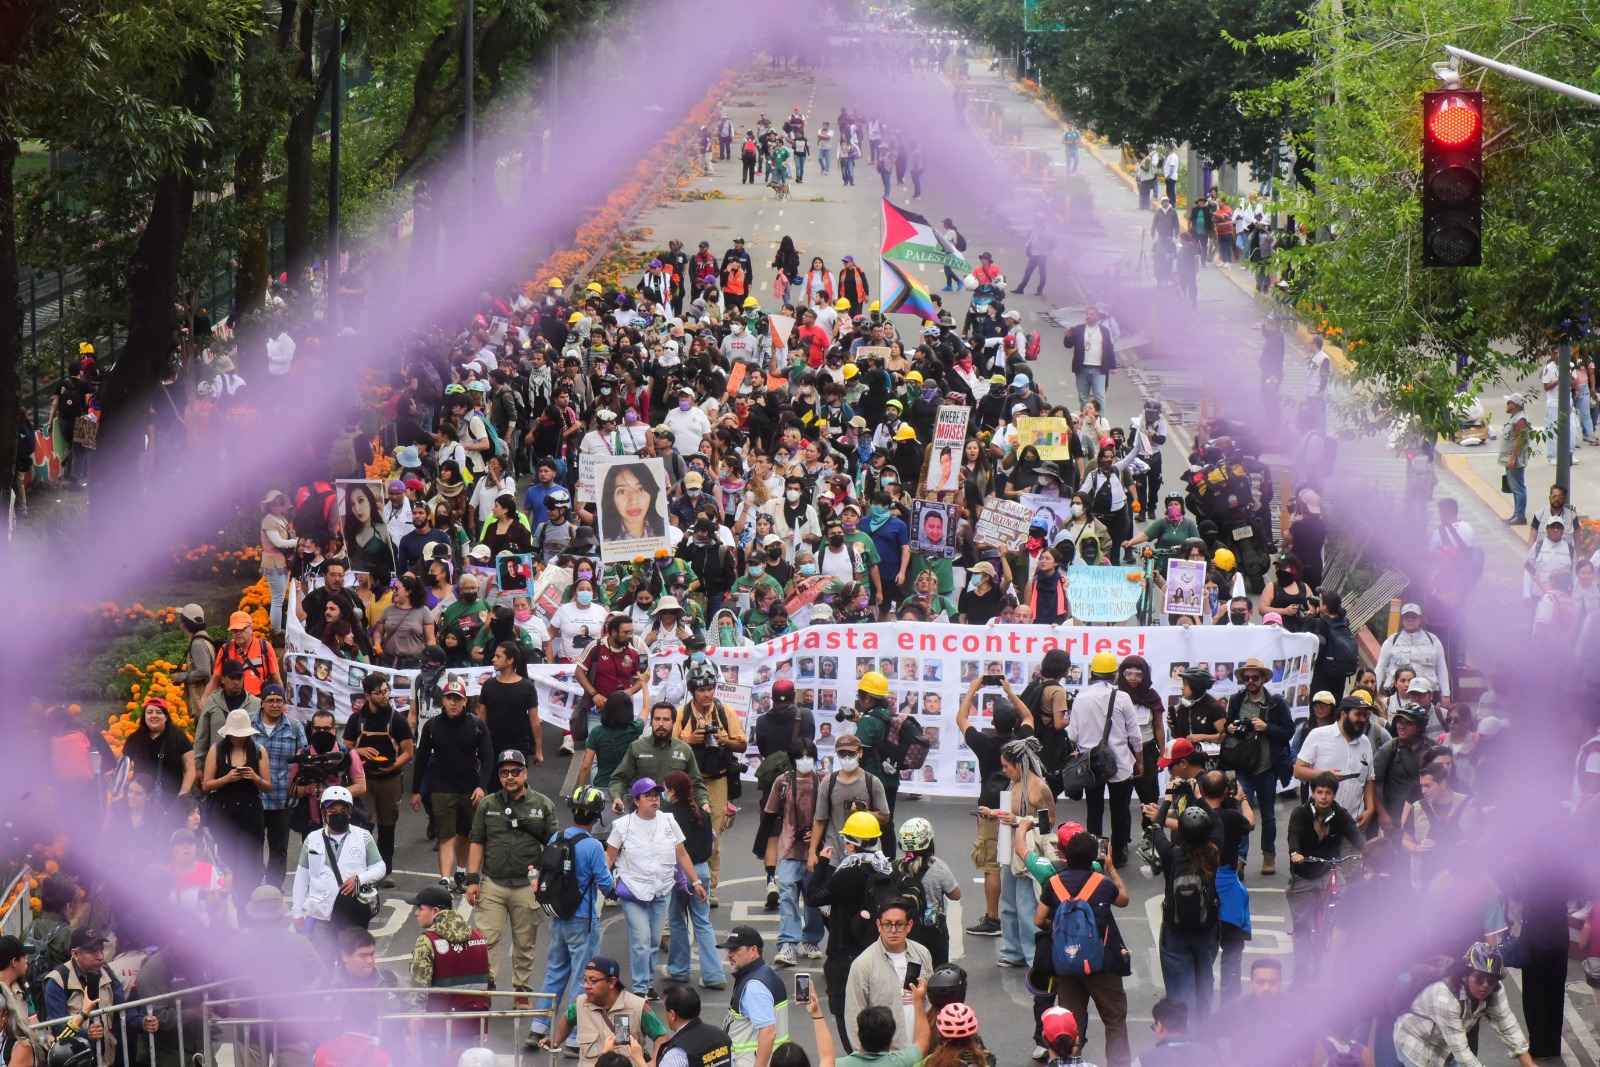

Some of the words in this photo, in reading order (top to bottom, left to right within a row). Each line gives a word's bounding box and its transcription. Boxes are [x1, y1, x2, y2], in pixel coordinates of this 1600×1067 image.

[906, 249, 969, 270] PALESTINE
[940, 410, 959, 424] WHERE
[960, 411, 967, 424] IS
[1018, 418, 1065, 429] JUSTICIA
[767, 628, 879, 657] ¡Hasta
[897, 631, 1146, 657] encontrarles!
